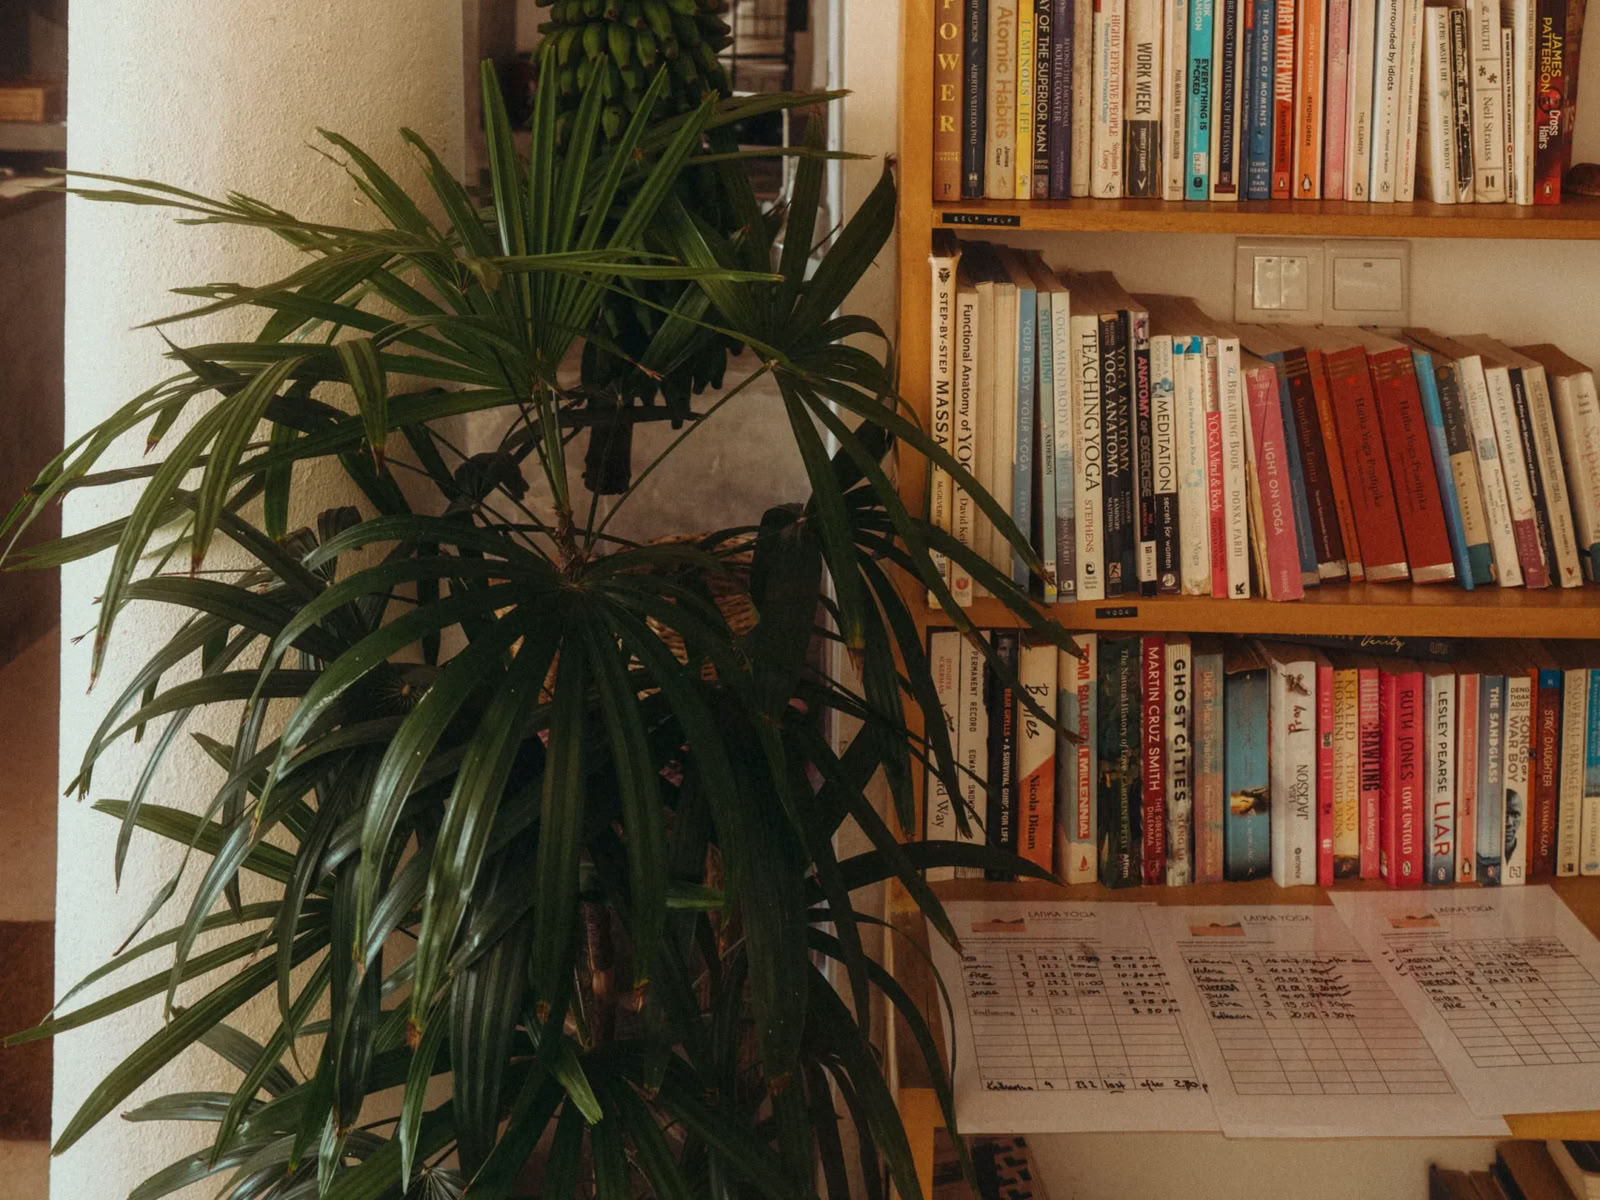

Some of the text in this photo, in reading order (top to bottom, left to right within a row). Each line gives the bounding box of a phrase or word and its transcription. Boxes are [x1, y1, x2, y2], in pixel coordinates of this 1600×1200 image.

[1038, 36, 1049, 58] THE
[1039, 15, 1050, 33] OF
[1261, 29, 1269, 62] POWER
[1277, 34, 1293, 71] WITH
[1541, 17, 1551, 93] PATTERSON
[1551, 33, 1562, 77] JAMES
[995, 6, 1013, 139] Atomic Habits
[1037, 62, 1049, 120] SUPERIOR
[1136, 42, 1152, 79] WORK
[1261, 66, 1268, 78] OF
[1276, 73, 1292, 102] WHY
[1135, 82, 1150, 115] WEEK
[1199, 58, 1209, 130] EVERYTHING IS
[1259, 81, 1268, 127] MOMENTS
[1002, 146, 1010, 168] James
[1036, 125, 1047, 152] MAN
[954, 215, 979, 223] SELF
[939, 292, 948, 374] STEP-BY-STEP
[960, 304, 973, 432] Functional Anatomy of
[1080, 330, 1100, 553] TEACHING YOGA STEPHENS
[1105, 350, 1118, 478] YOGA ANATOMY
[1156, 401, 1173, 569] MEDITATION secrets for women
[1207, 414, 1223, 512] YOGA Mind & Body
[1263, 441, 1284, 536] LIGHT ON YOGA
[969, 651, 978, 732] PERMANENT RECORD
[1147, 647, 1160, 791] MARTIN CRUZ SMITH
[1345, 680, 1355, 741] KHALED
[1173, 659, 1187, 802] GHOST CITIES
[1487, 687, 1499, 784] THE SANDGLASS
[1507, 715, 1518, 783] WAR BOY
[1519, 715, 1529, 764] SONGS
[1398, 690, 1414, 854] RUTH JONES LOVE UNTOLD
[1433, 692, 1451, 857] LESLEY PEARSE LIAR
[1521, 766, 1527, 775] OF
